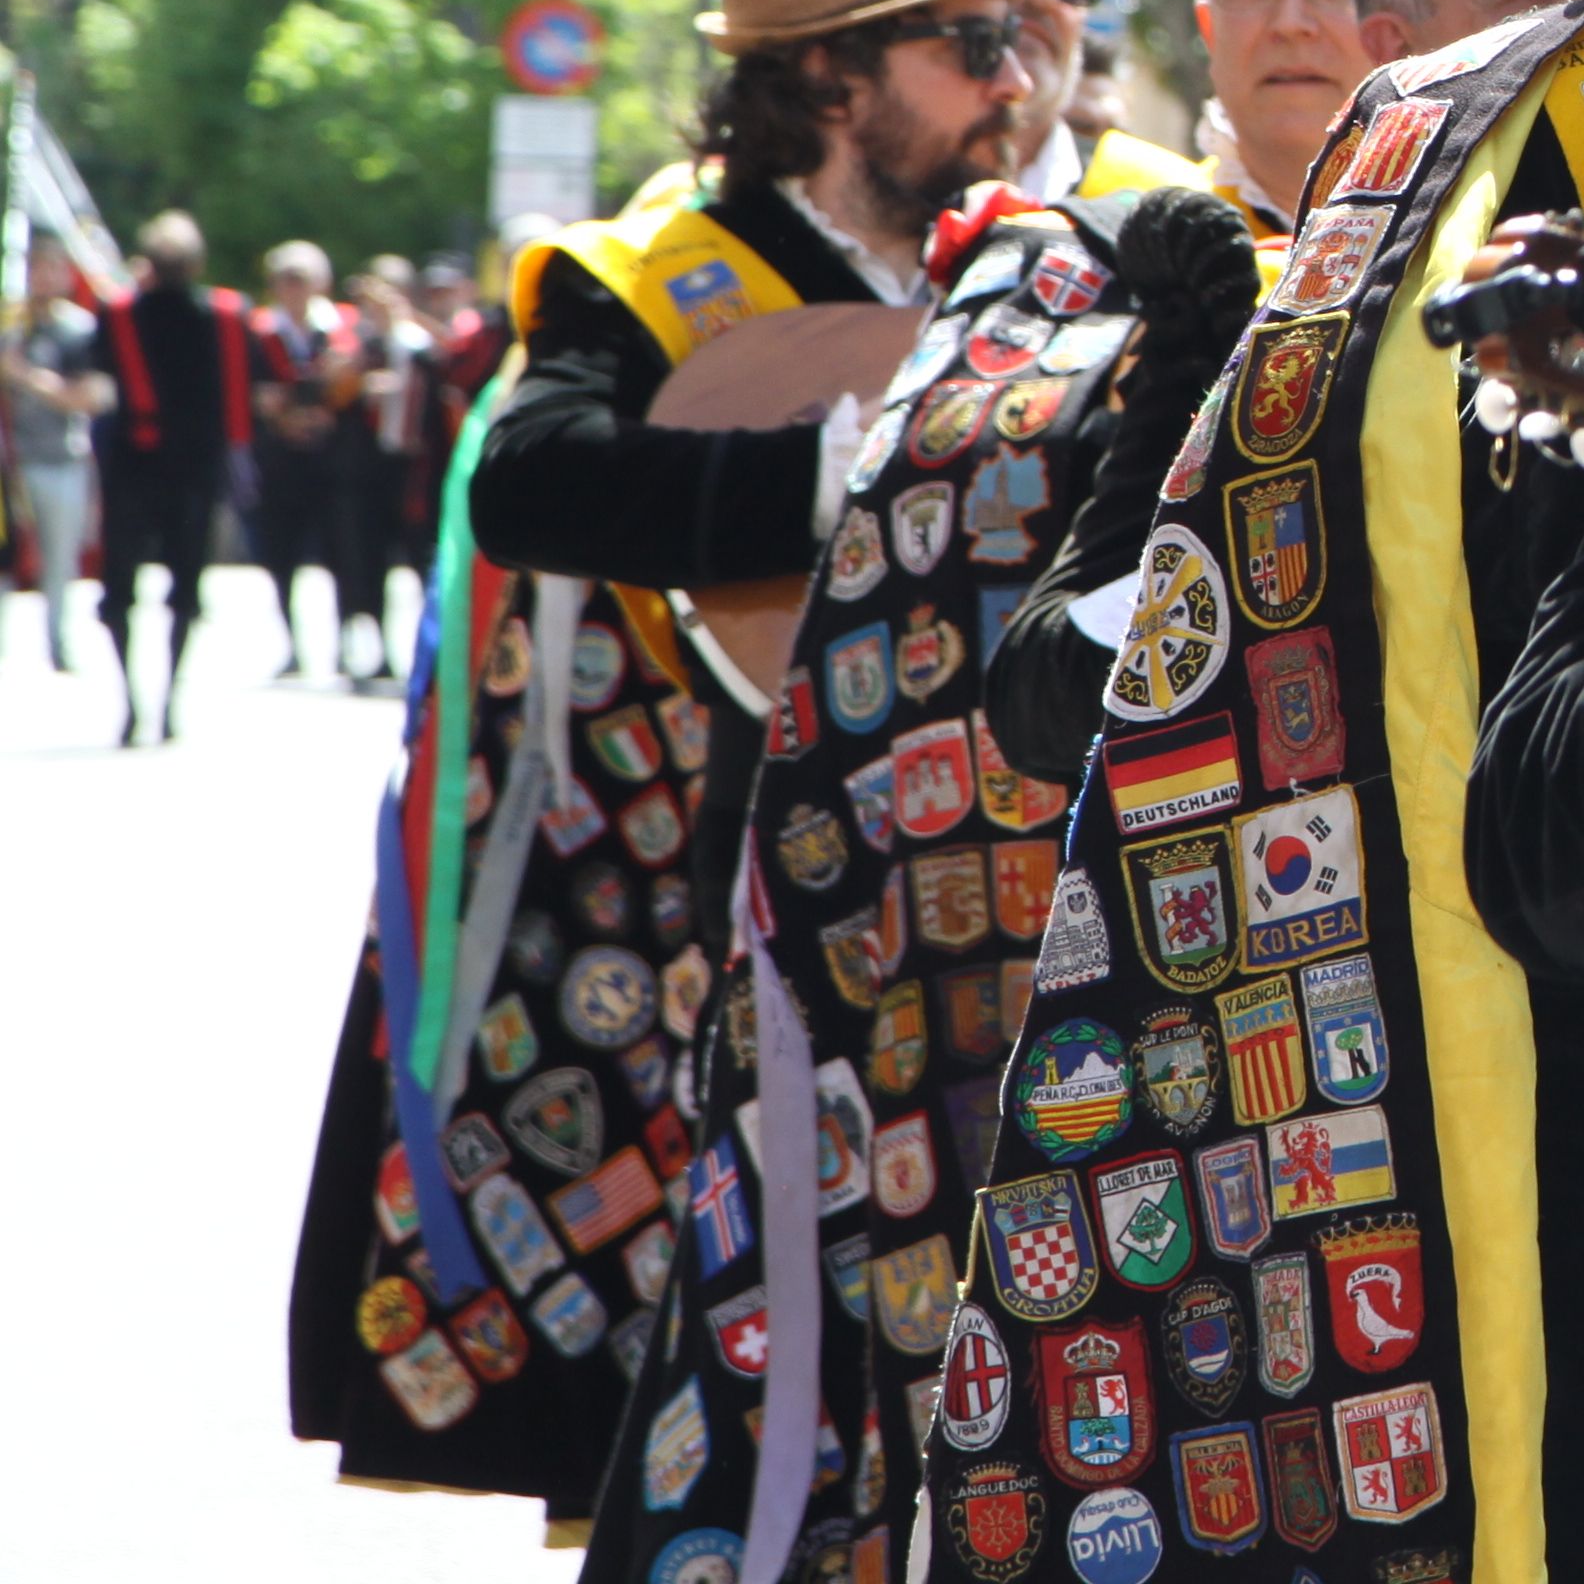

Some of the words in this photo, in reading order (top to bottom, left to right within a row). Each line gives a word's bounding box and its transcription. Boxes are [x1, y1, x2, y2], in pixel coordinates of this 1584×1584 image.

[1122, 784, 1240, 828] DEUTSCHLAND
[1251, 910, 1359, 959] KOREA
[1166, 956, 1228, 984] BADAJOZ
[1223, 981, 1289, 1015] VALENCIA
[991, 1176, 1067, 1206] HRVATSKA
[1098, 1173, 1137, 1192] LLORET
[1137, 1167, 1150, 1182] DE
[1153, 1160, 1175, 1180] MAR
[1002, 1266, 1096, 1317] CROATIA
[949, 1475, 1041, 1500] LANGUEDOC
